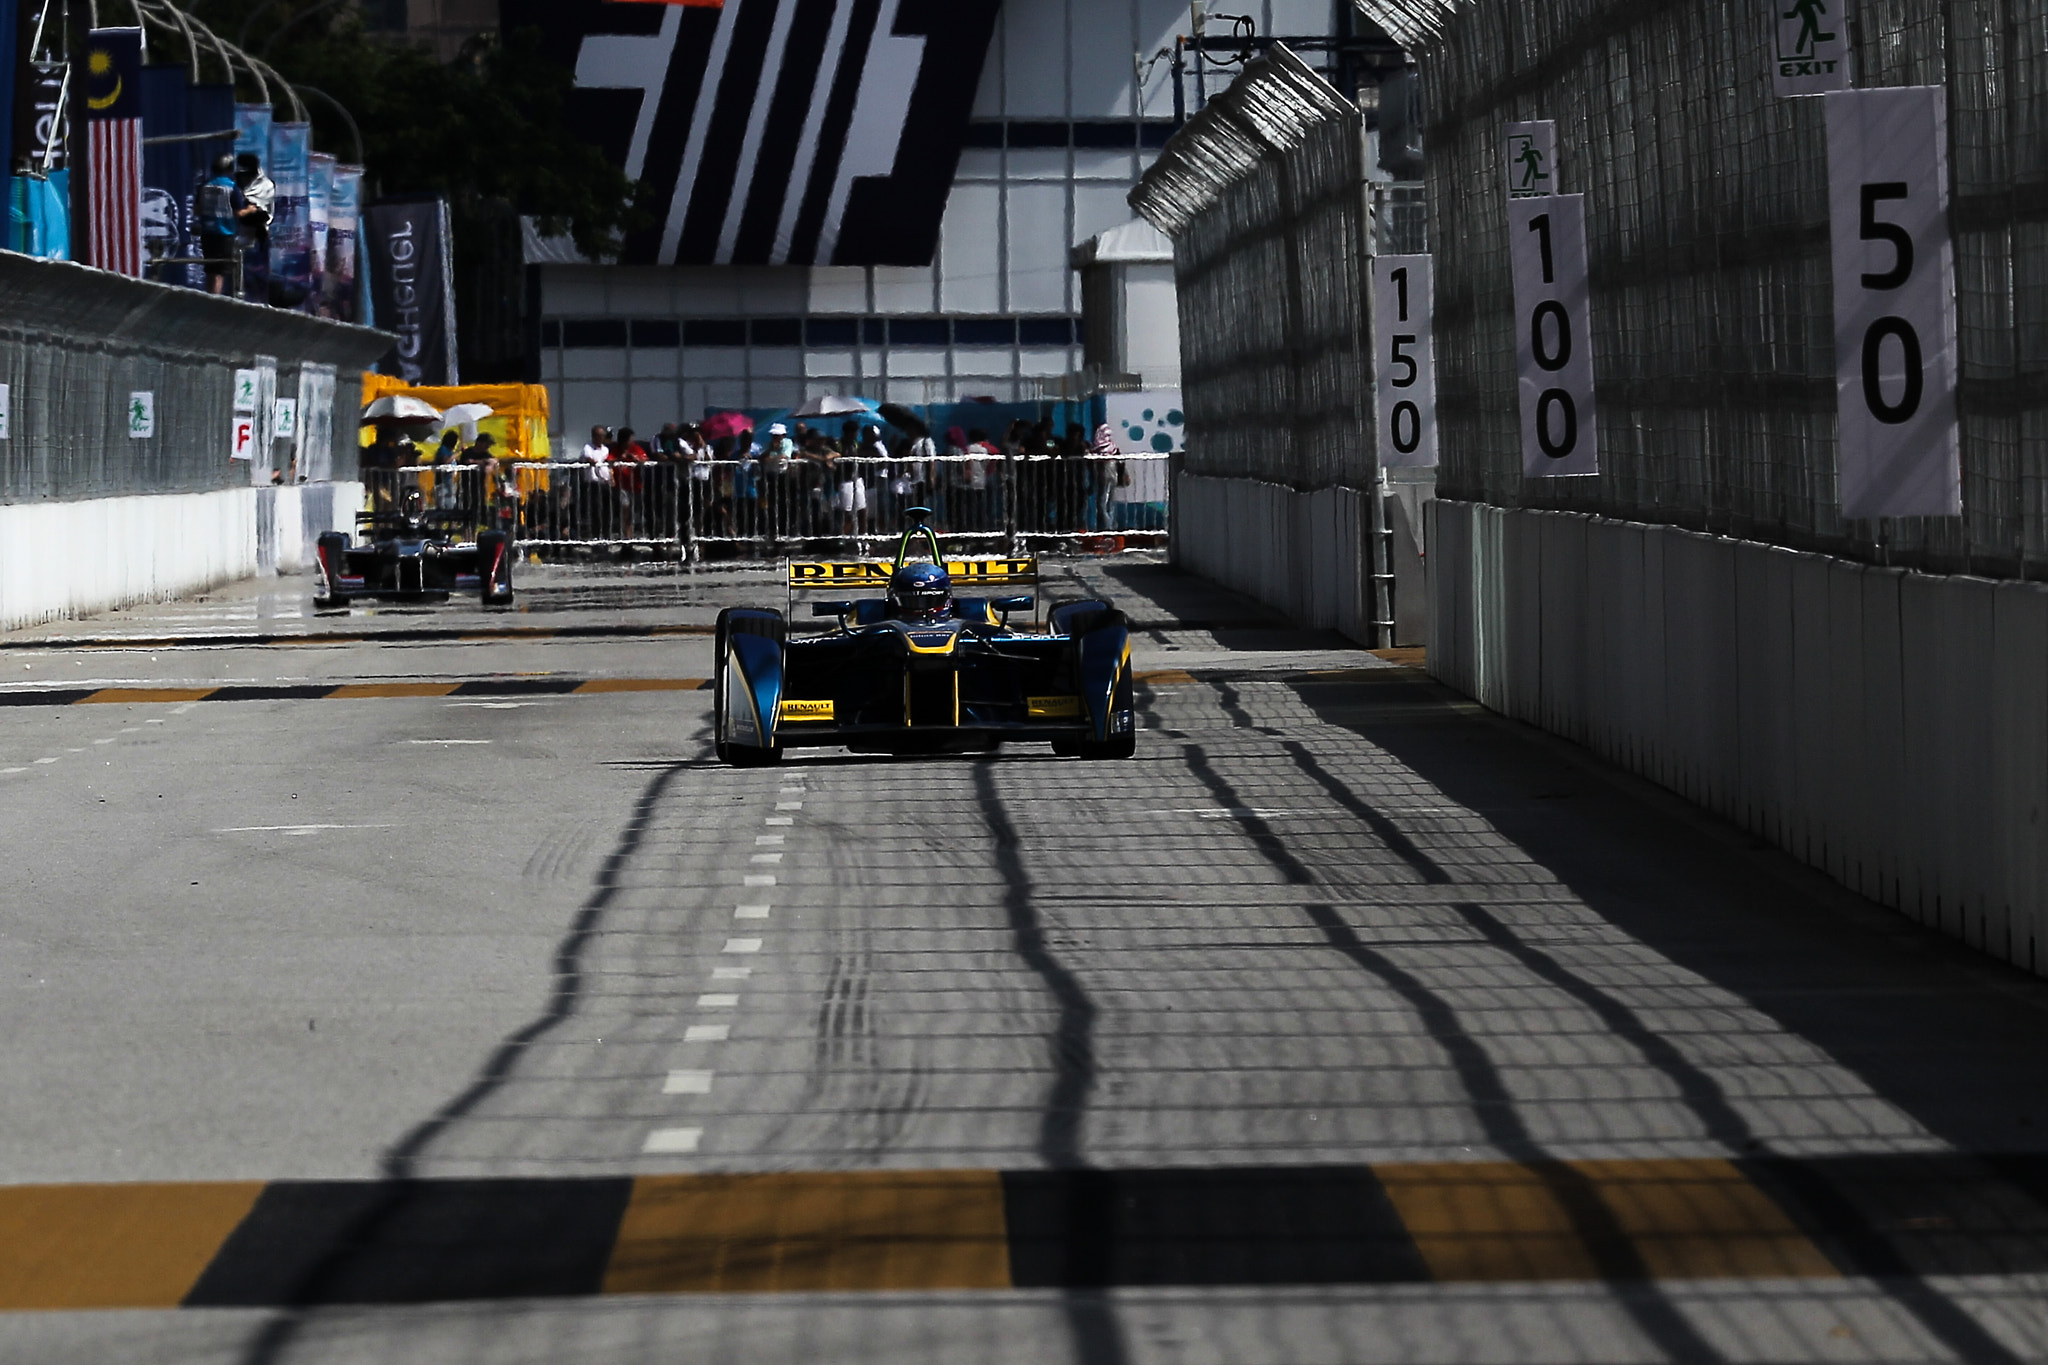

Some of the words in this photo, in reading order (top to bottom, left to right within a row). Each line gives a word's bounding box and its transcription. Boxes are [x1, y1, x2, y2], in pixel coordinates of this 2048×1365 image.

[1779, 60, 1838, 77] EXIT
[1528, 213, 1578, 459] 100
[1860, 182, 1924, 425] 50
[1390, 268, 1421, 453] 150
[237, 424, 251, 453] F
[792, 560, 1030, 583] RENULT
